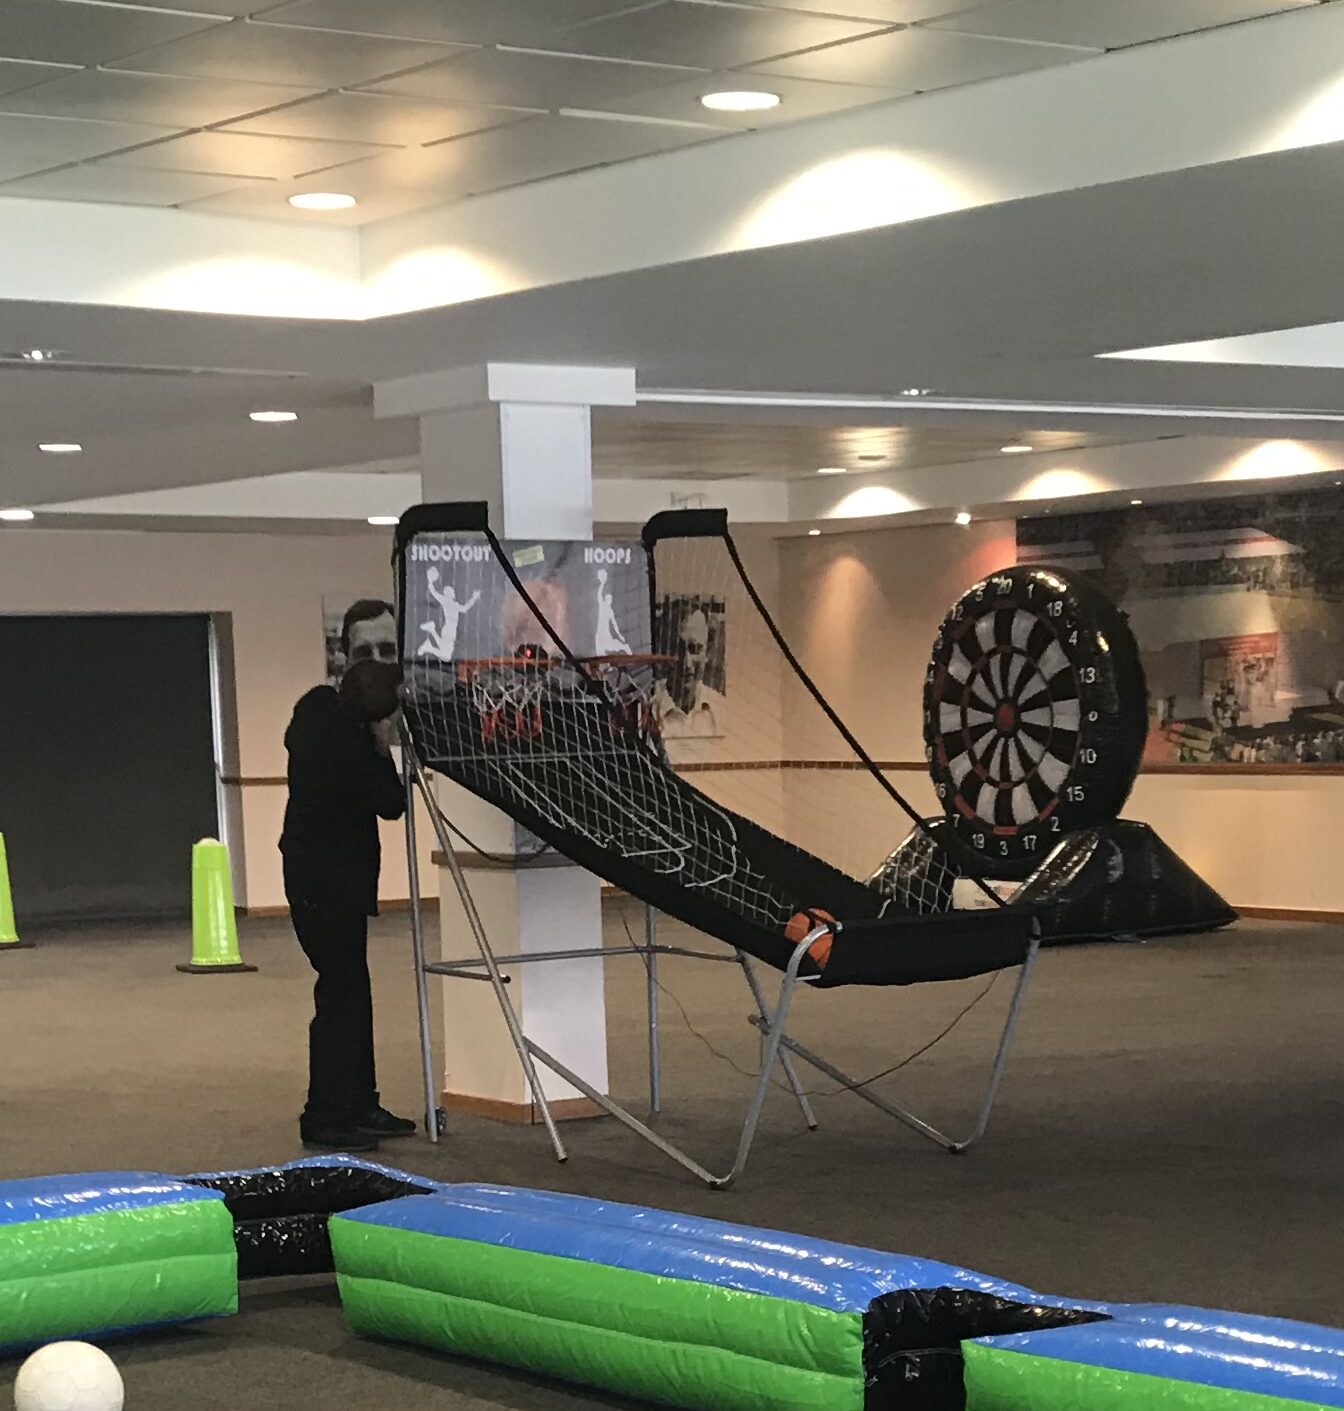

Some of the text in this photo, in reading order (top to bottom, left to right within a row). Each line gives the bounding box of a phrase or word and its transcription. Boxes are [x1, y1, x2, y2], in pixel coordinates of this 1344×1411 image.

[411, 544, 632, 564] SHOOTOUT HOOPS
[1027, 583, 1035, 599] 1
[1046, 600, 1063, 617] 18
[1068, 630, 1078, 646] 4
[1079, 667, 1096, 684] 13
[1079, 748, 1097, 764] 10
[1066, 786, 1085, 802] 15
[952, 813, 961, 828] 7
[1050, 816, 1061, 832] 2
[999, 840, 1009, 856] 3
[1022, 834, 1037, 851] 17
